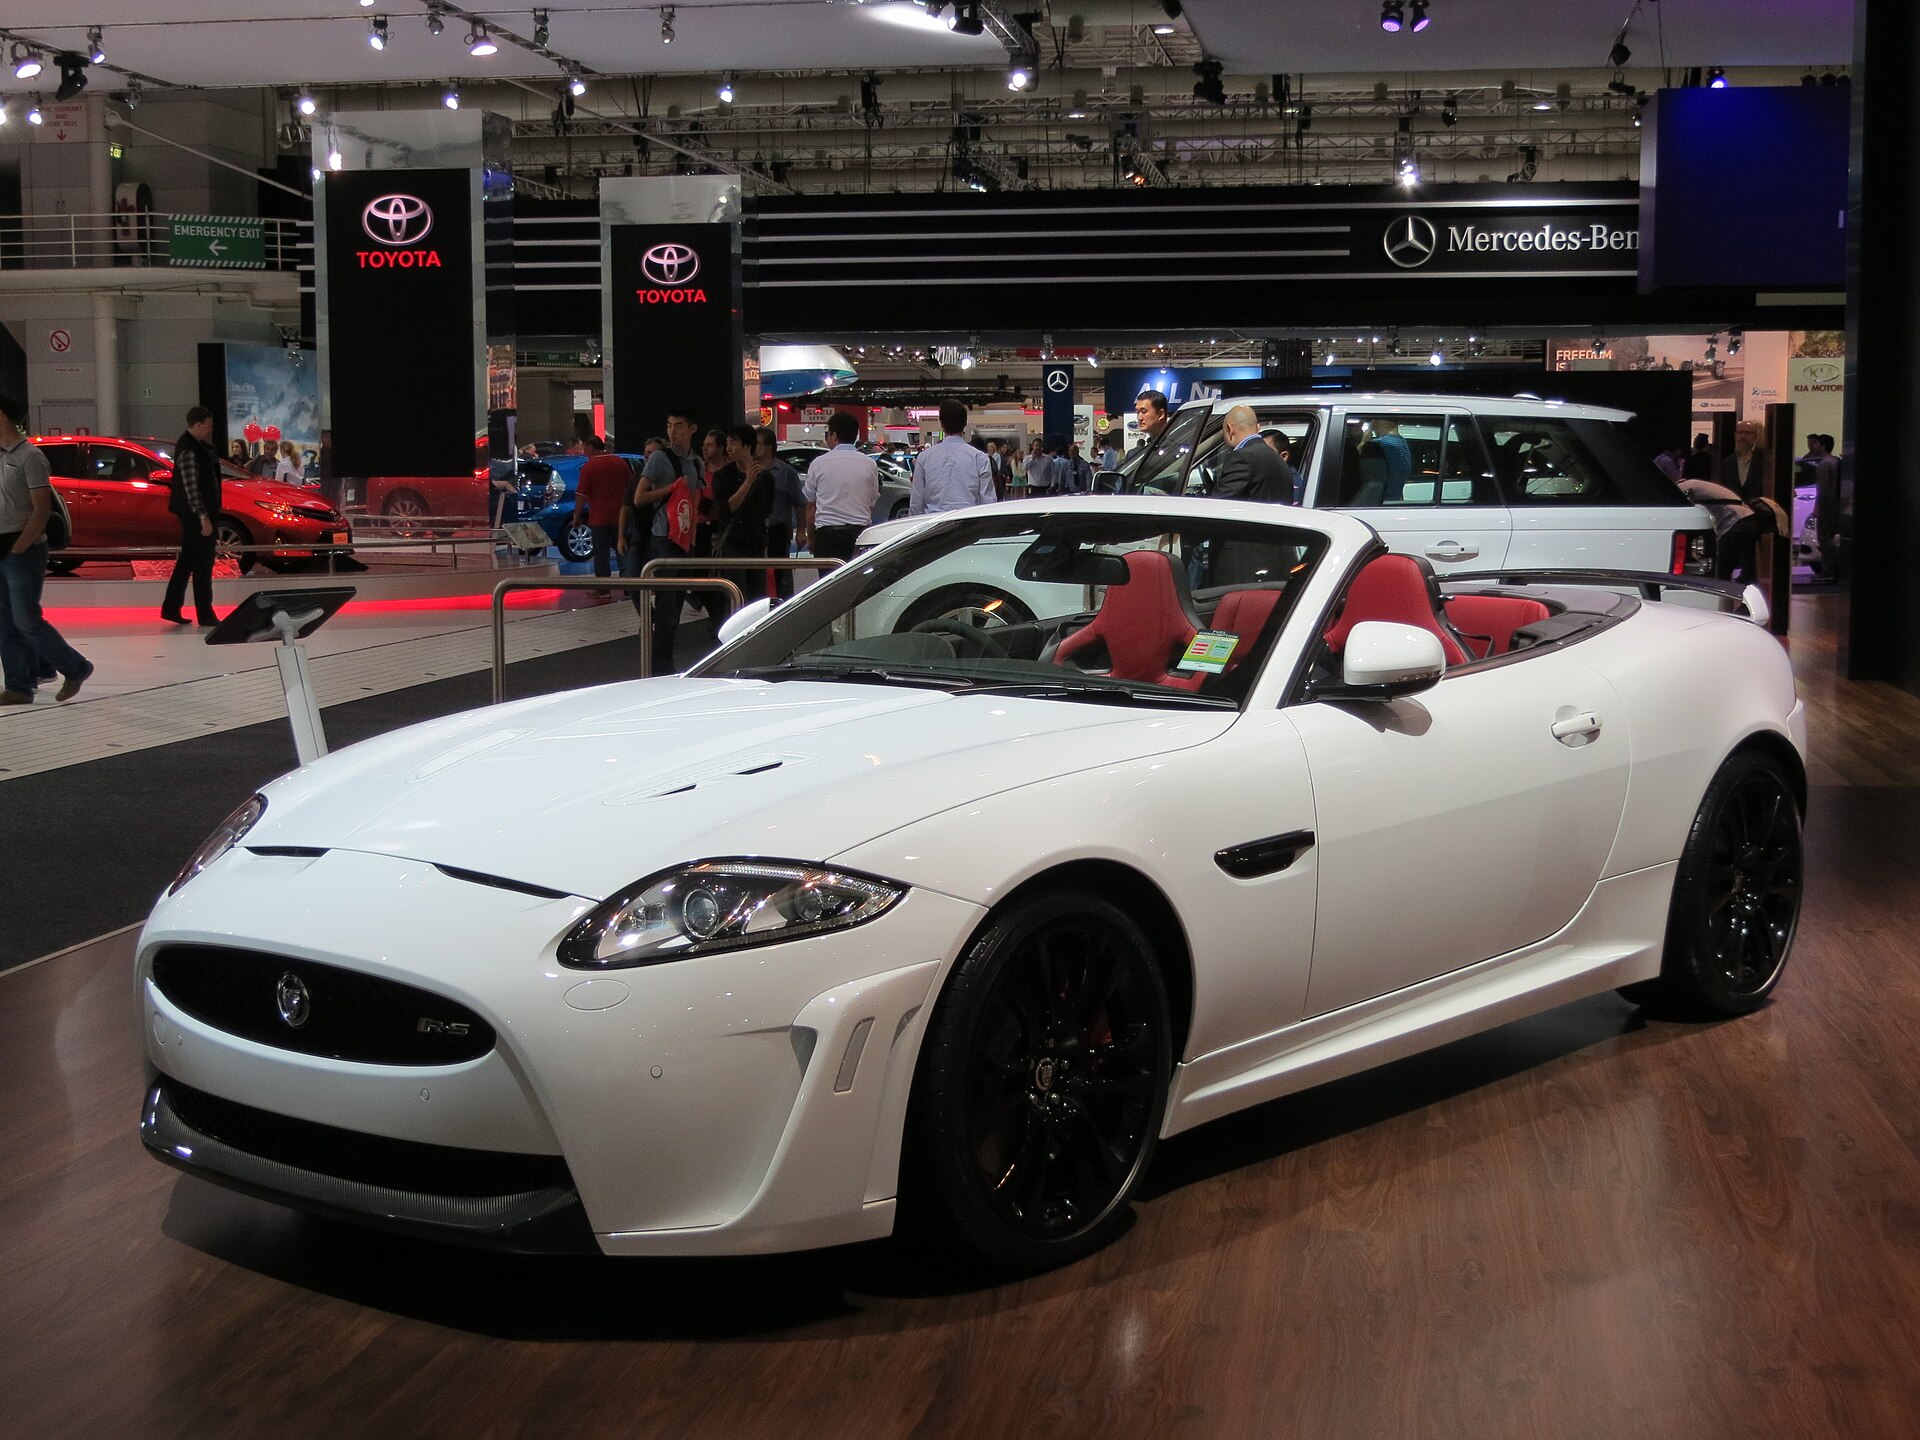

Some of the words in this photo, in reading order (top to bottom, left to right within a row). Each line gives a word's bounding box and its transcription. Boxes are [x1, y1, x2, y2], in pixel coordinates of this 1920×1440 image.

[174, 225, 237, 238] EMERGENCY
[239, 228, 261, 239] EXIT
[1447, 225, 1639, 252] Mercedes-Ben
[356, 250, 442, 269] TOYOTA
[636, 289, 707, 304] TOYOTA
[1556, 350, 1612, 361] FREEDOM
[1794, 384, 1809, 392] KIA
[803, 408, 833, 416] ISUZU
